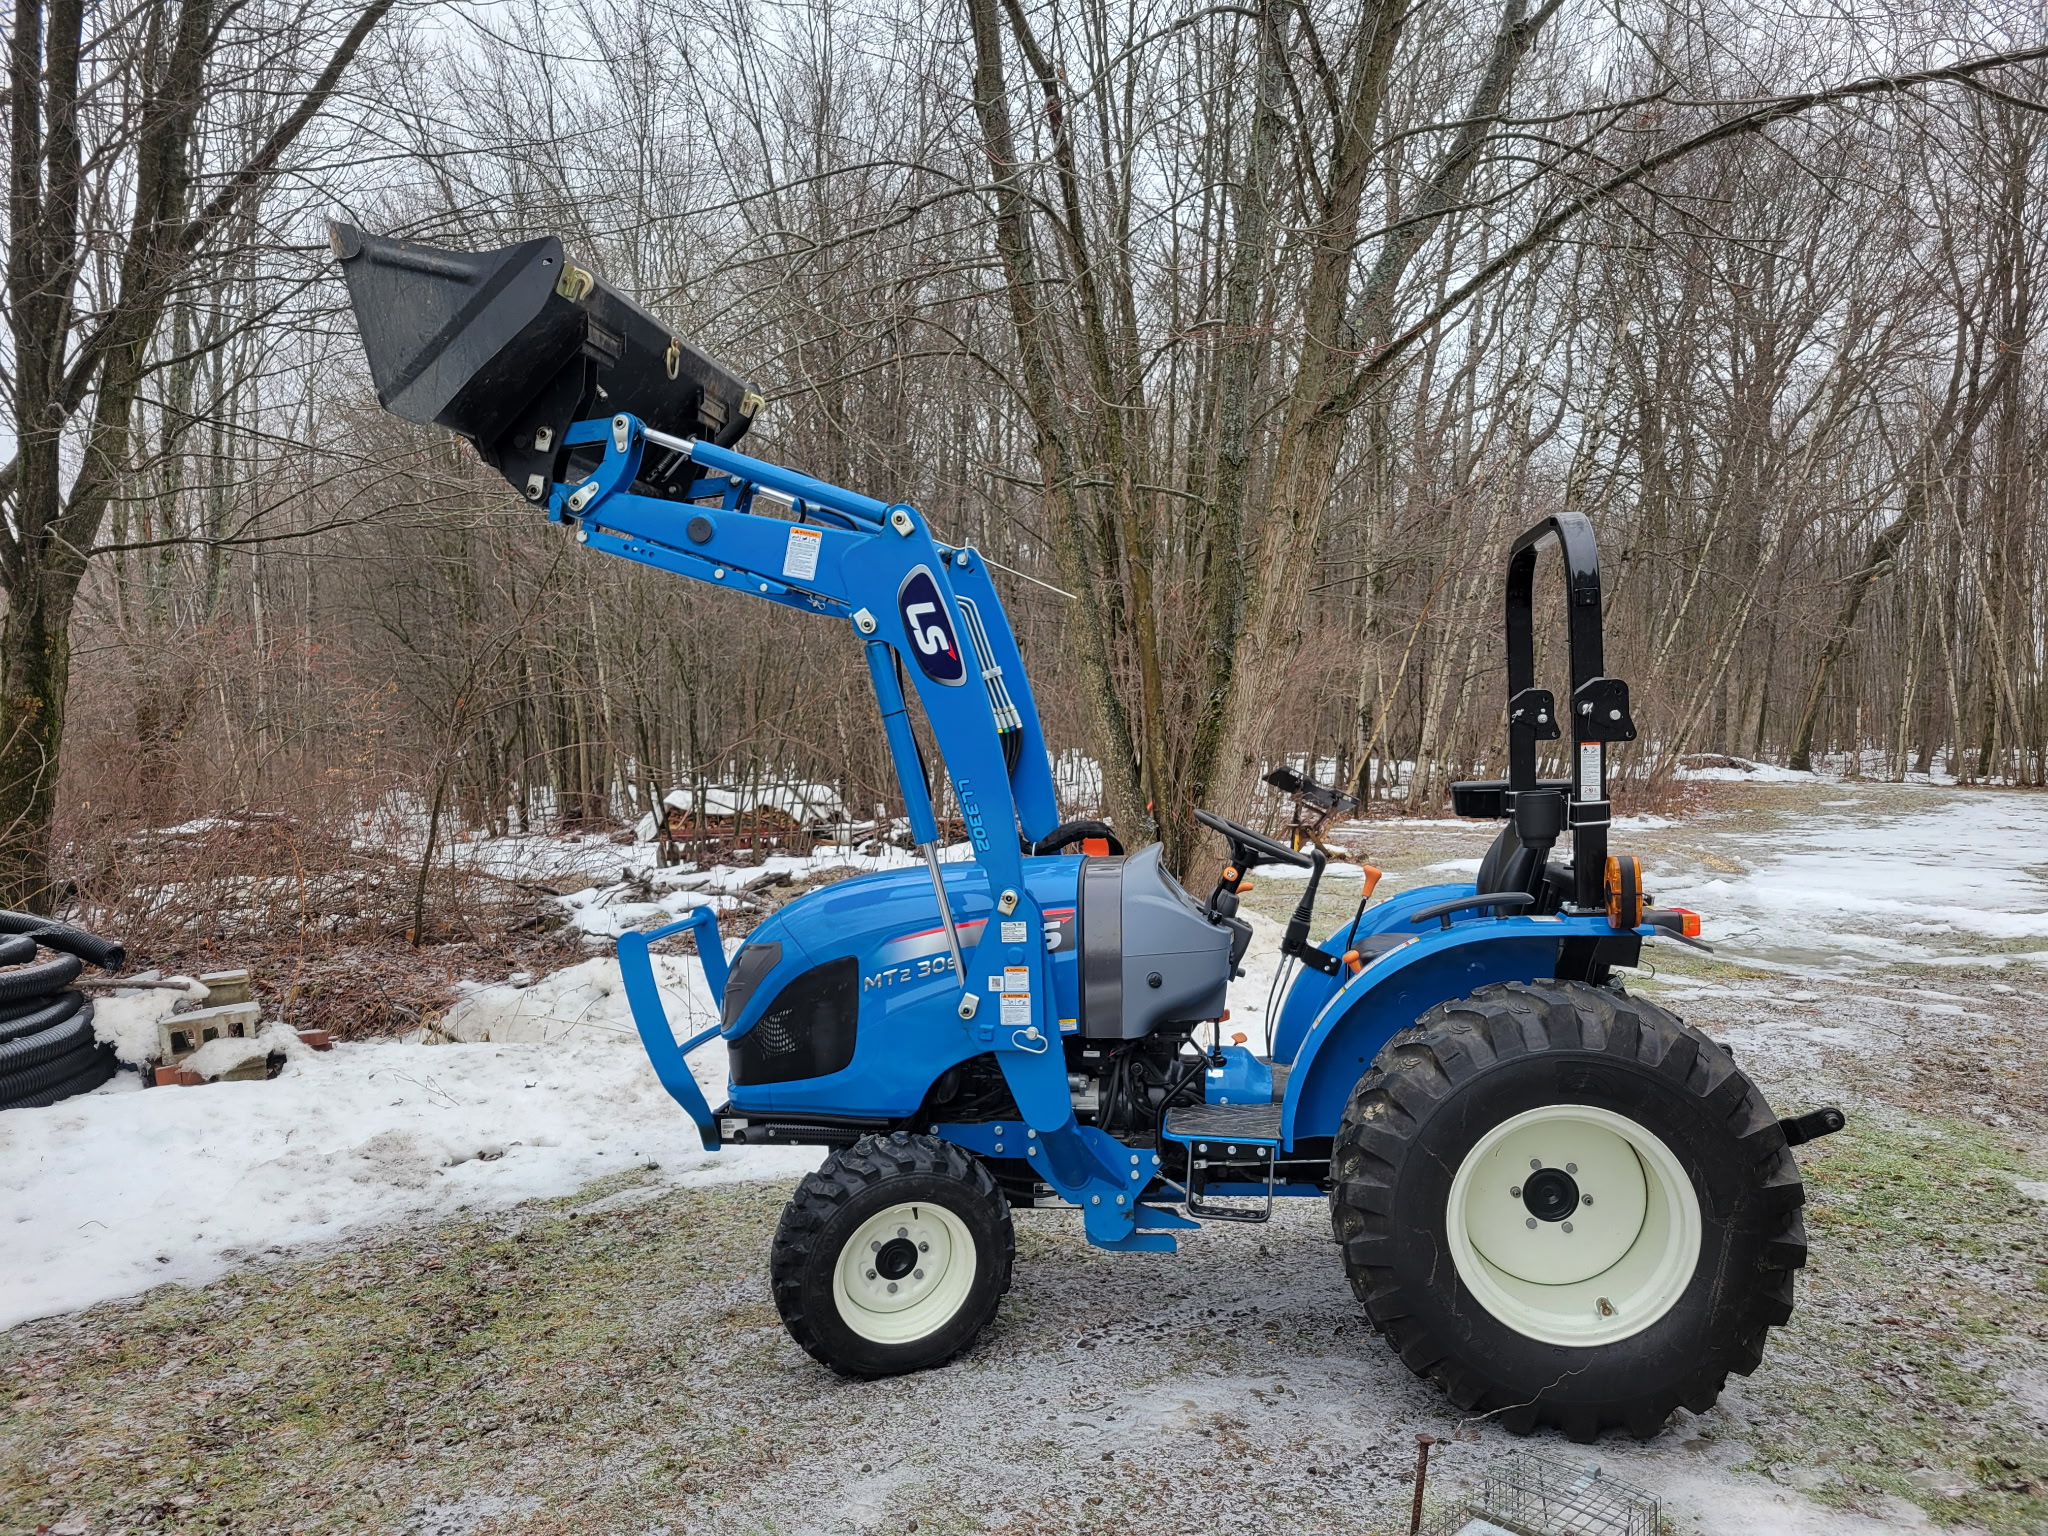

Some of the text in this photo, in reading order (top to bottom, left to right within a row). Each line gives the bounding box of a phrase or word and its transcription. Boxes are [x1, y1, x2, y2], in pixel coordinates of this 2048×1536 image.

[906, 602, 949, 655] LS
[958, 779, 990, 852] LL3302
[864, 968, 912, 992] MT2
